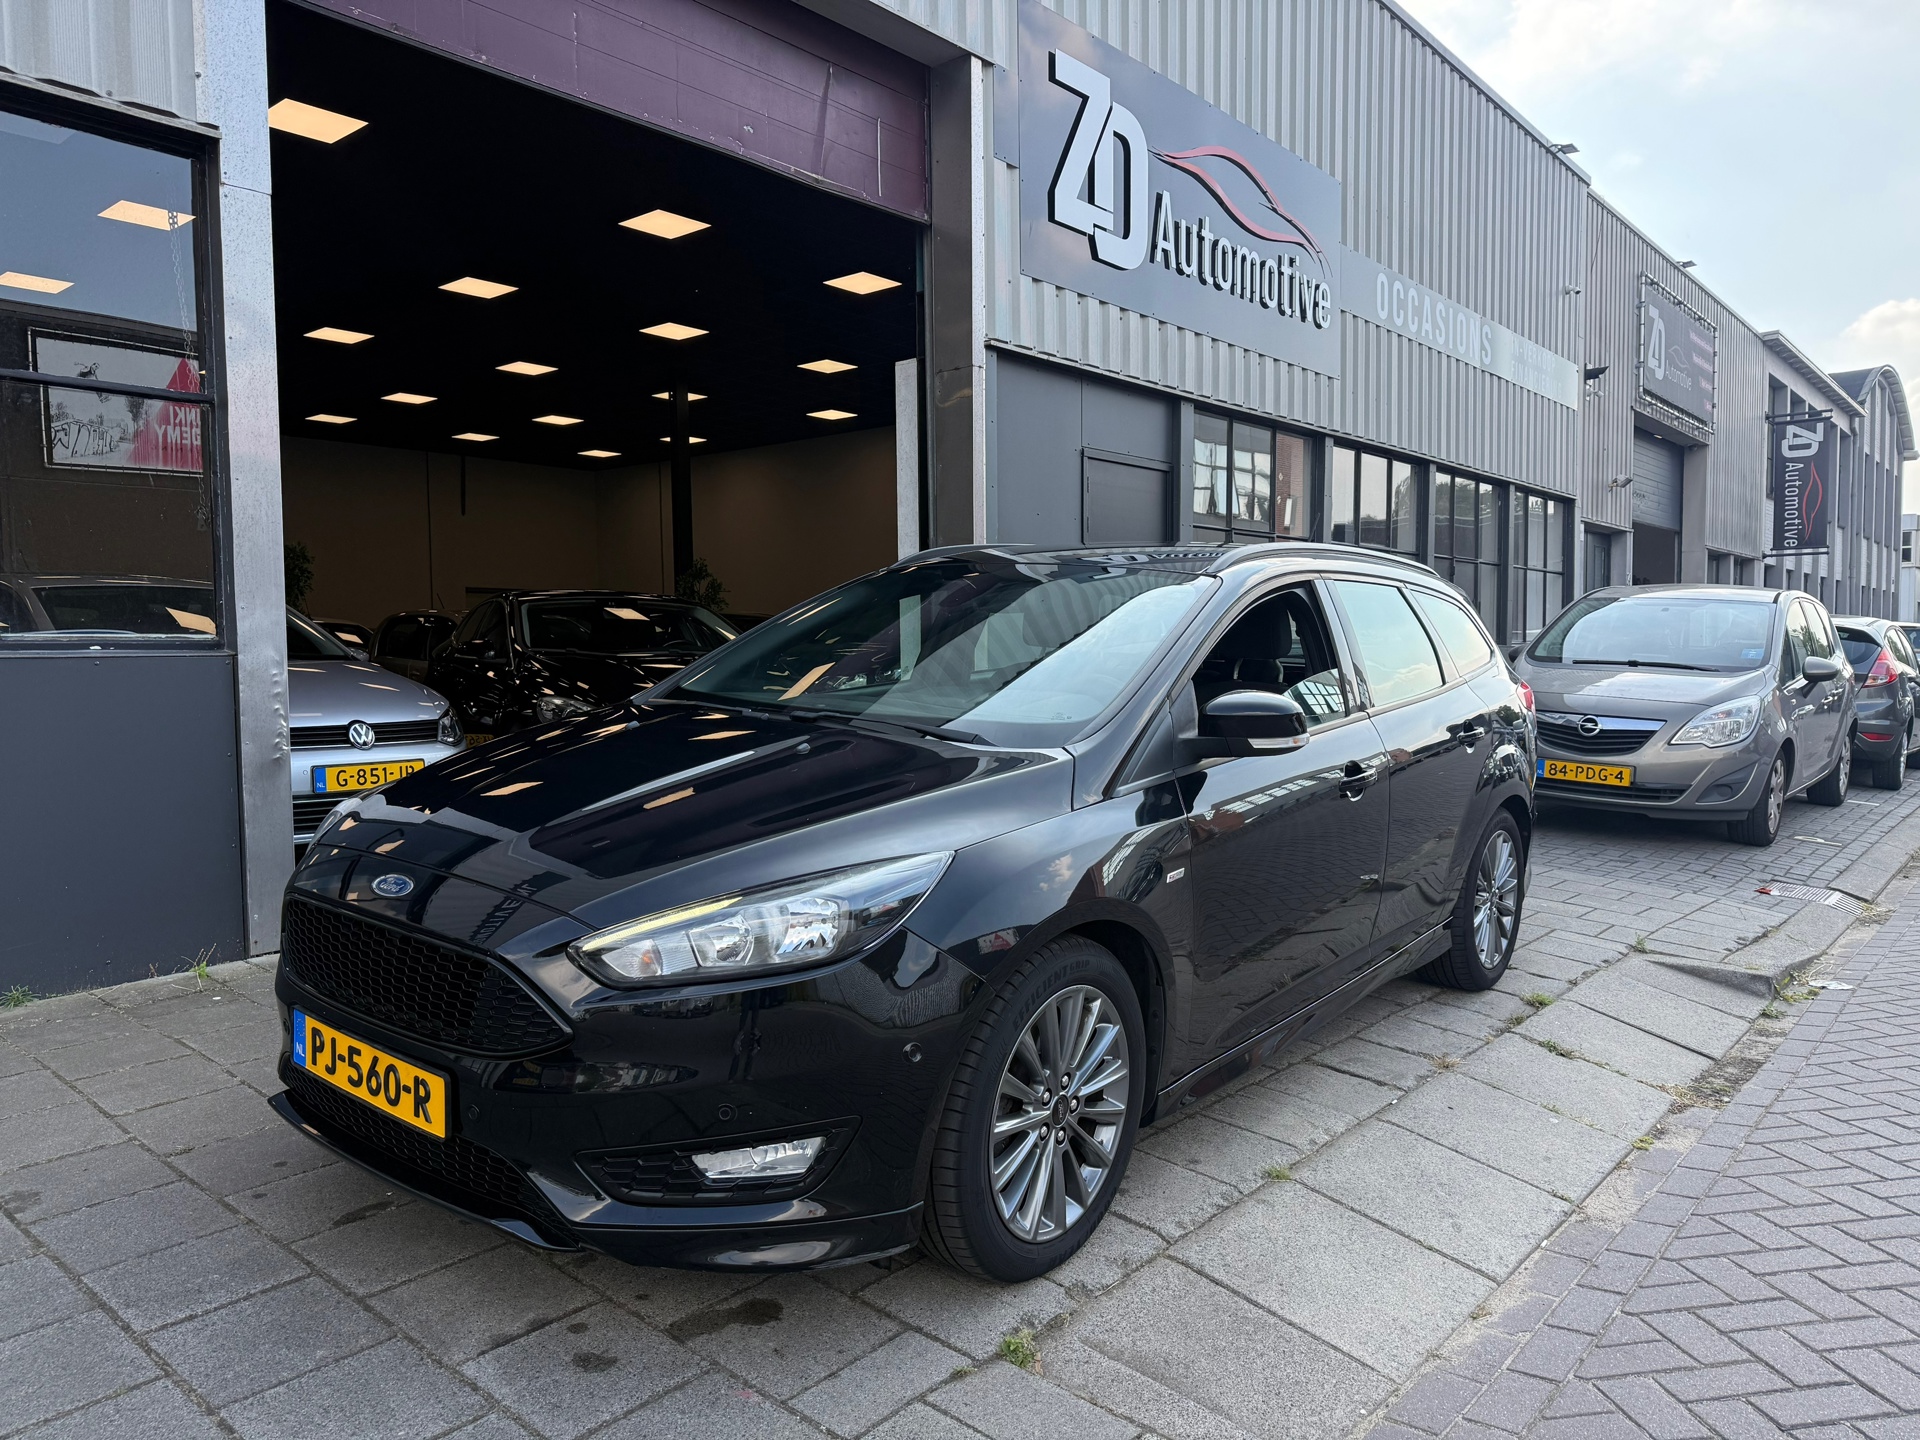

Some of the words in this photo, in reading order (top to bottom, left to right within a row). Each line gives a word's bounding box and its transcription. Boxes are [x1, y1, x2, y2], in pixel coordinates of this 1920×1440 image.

[1152, 189, 1331, 329] Automotive
[1376, 272, 1492, 365] OCCASIONS
[1783, 462, 1804, 548] Automotive
[1548, 763, 1625, 784] 84-PDG-4
[295, 1041, 305, 1057] NL
[311, 1026, 433, 1124] PJ-560-R
